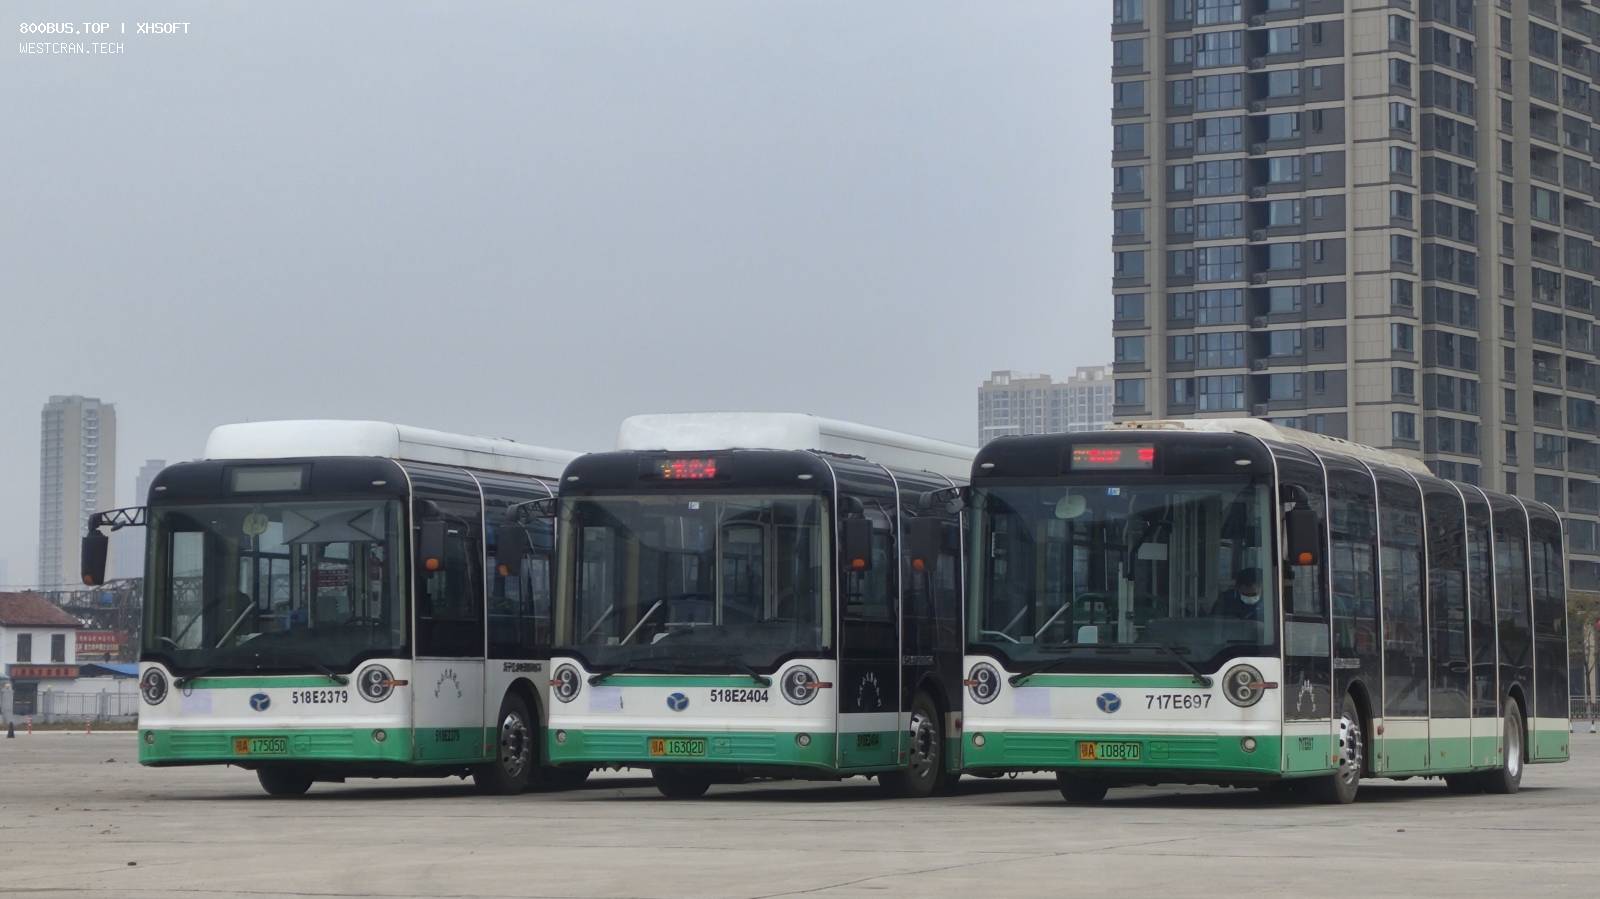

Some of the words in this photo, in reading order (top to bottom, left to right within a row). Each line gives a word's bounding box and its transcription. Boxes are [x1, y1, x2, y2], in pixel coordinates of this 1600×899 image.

[292, 690, 348, 704] 518E2379
[710, 689, 769, 703] 518E2404
[1145, 694, 1212, 710] 717E697
